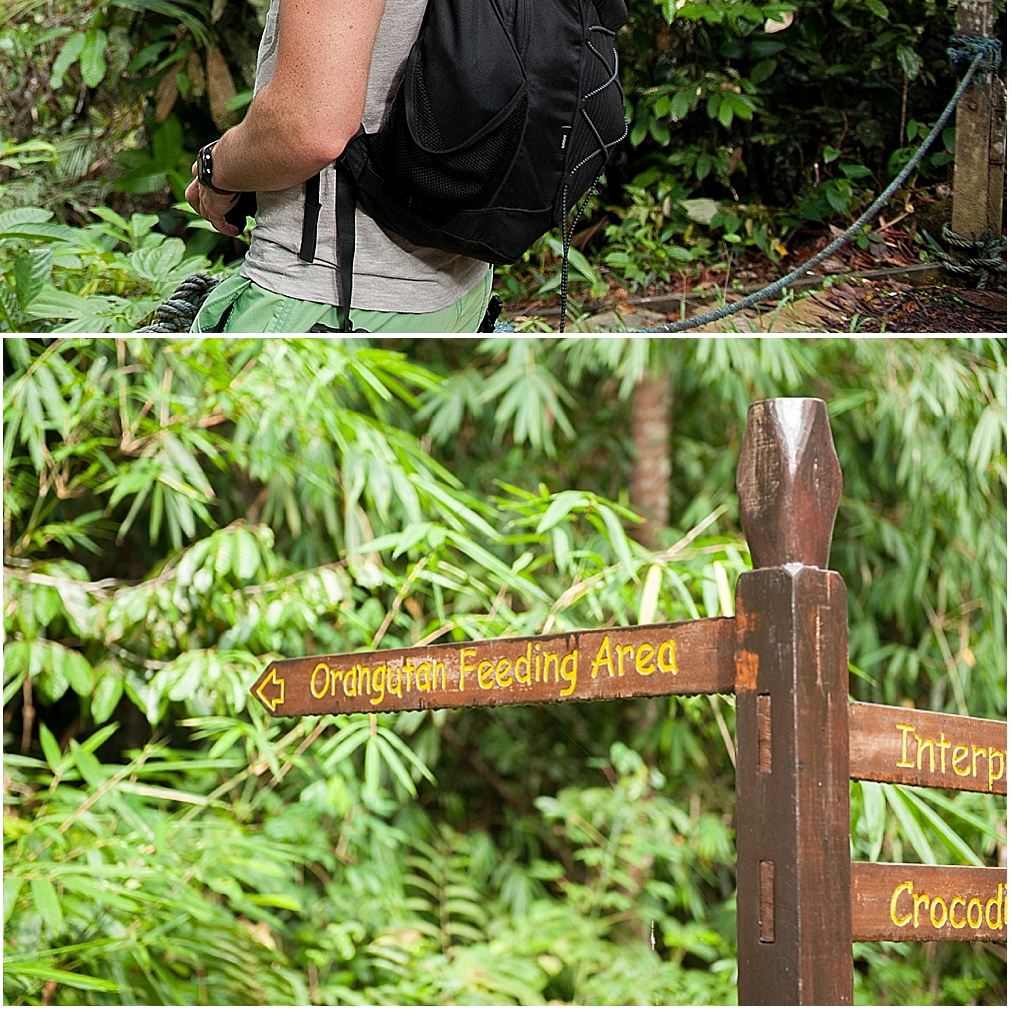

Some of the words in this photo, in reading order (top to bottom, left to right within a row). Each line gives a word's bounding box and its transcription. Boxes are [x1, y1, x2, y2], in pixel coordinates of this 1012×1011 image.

[310, 657, 447, 705] Orangutan
[458, 641, 579, 696] Feeding
[591, 635, 679, 678] Area
[896, 723, 1007, 791] Interp
